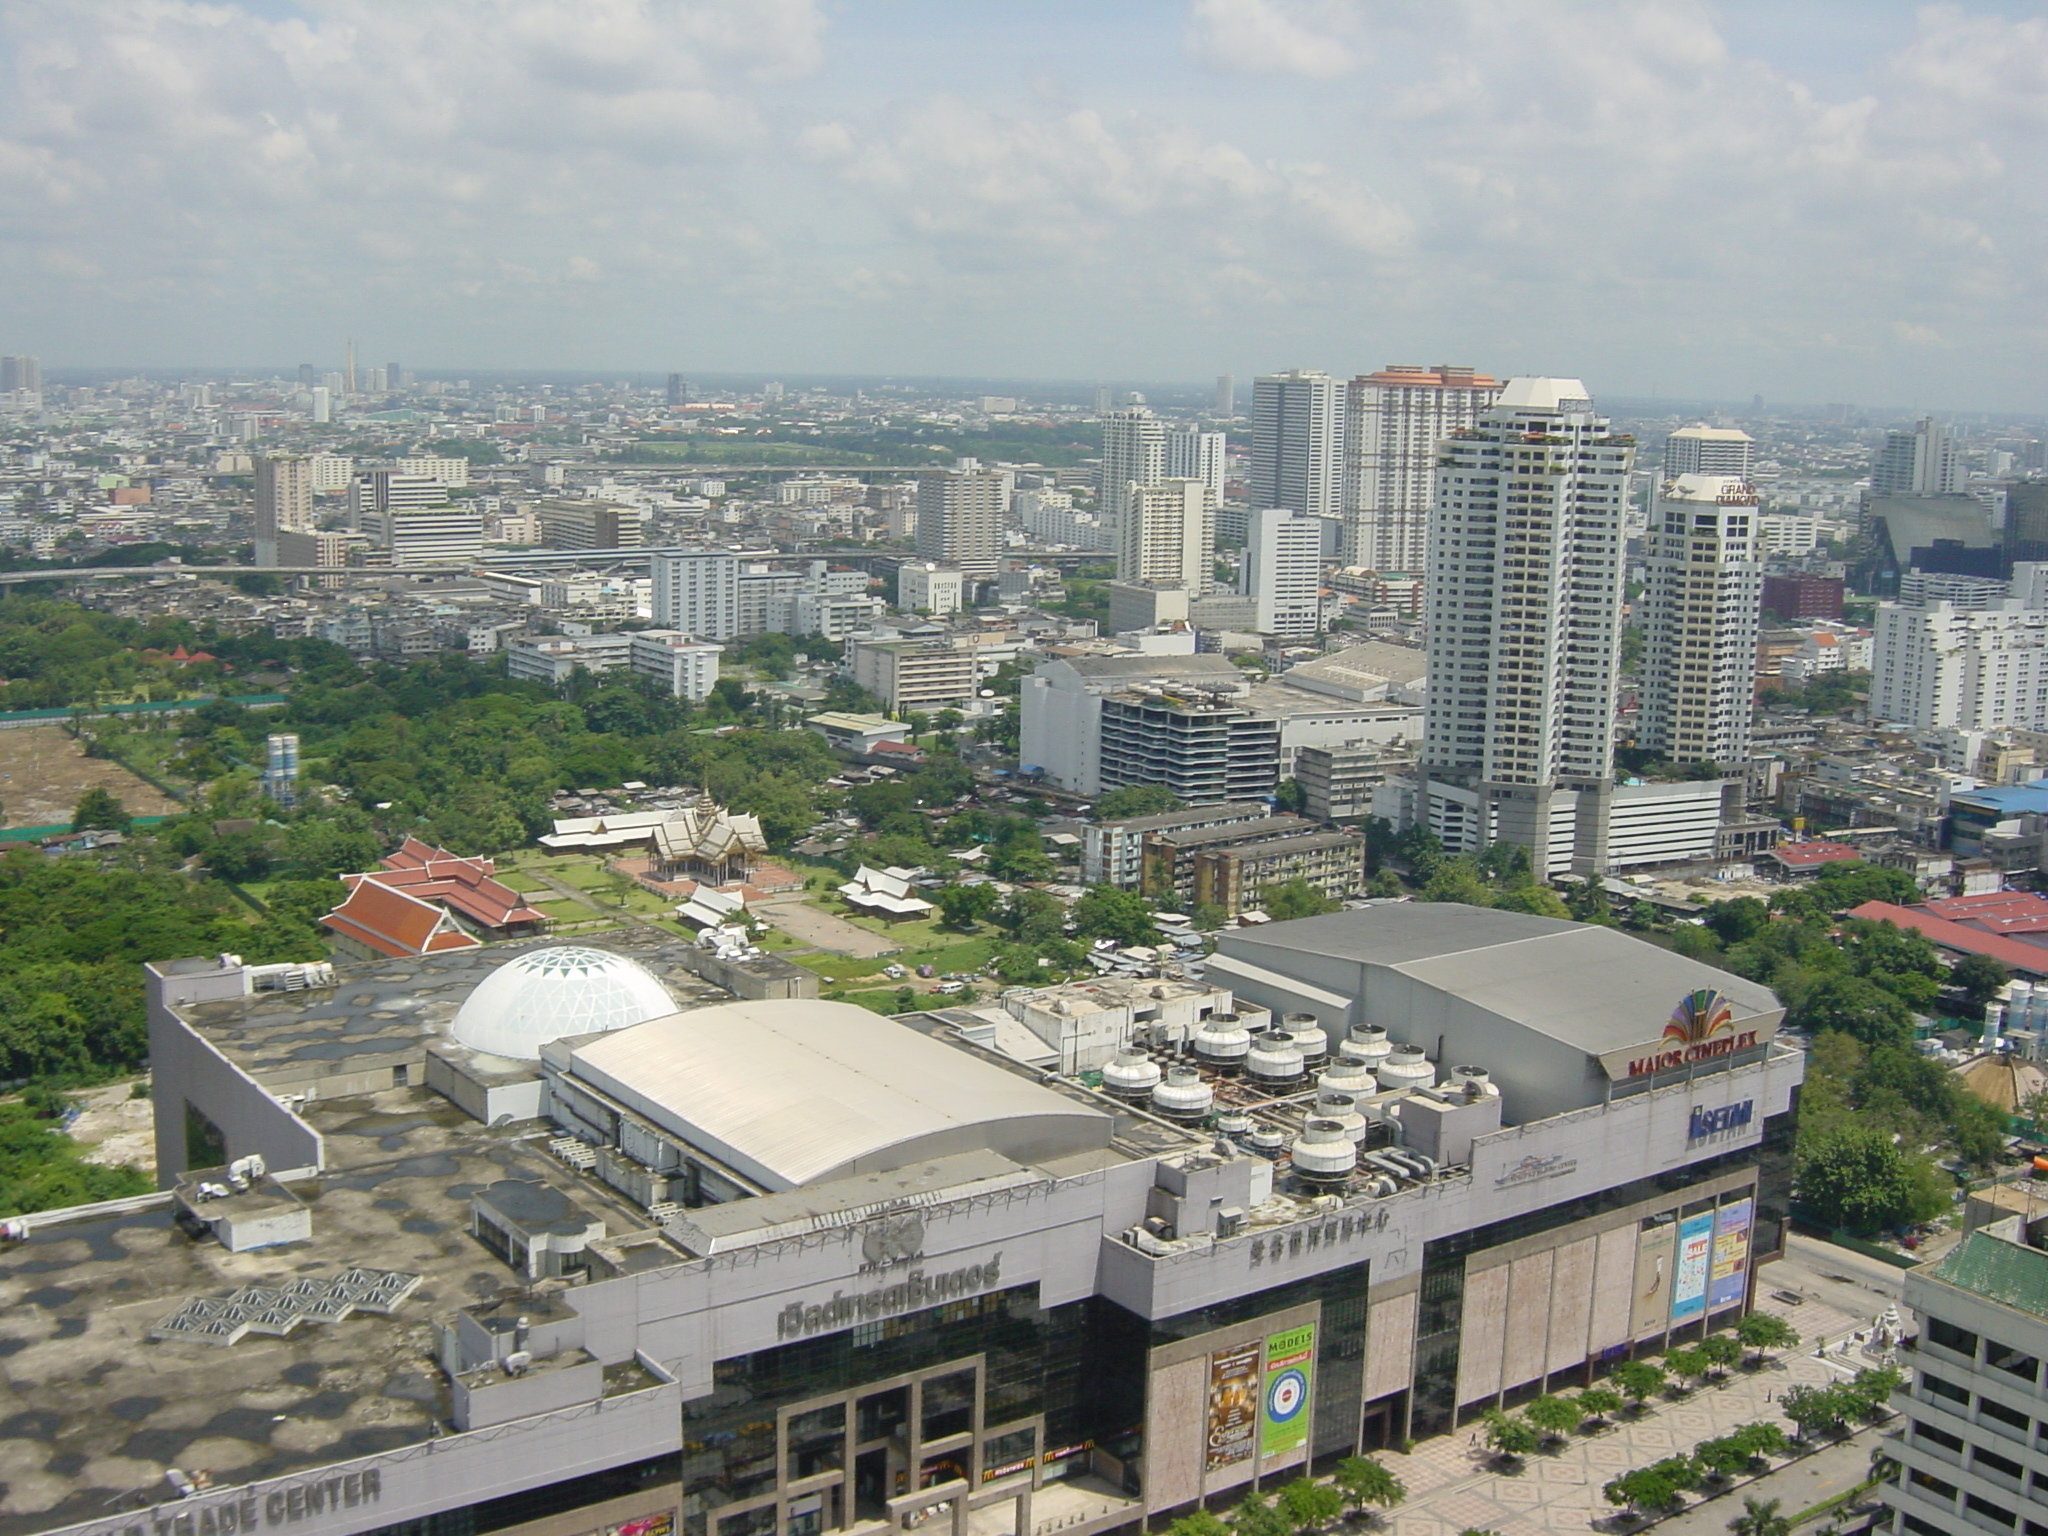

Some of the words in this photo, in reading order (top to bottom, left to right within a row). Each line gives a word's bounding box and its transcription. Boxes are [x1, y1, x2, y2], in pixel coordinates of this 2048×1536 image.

[1721, 485, 1756, 495] GRAND
[1628, 1049, 1682, 1077] MAJOR
[1684, 1030, 1758, 1063] CINEPLEX
[266, 1468, 381, 1526] CENTER
